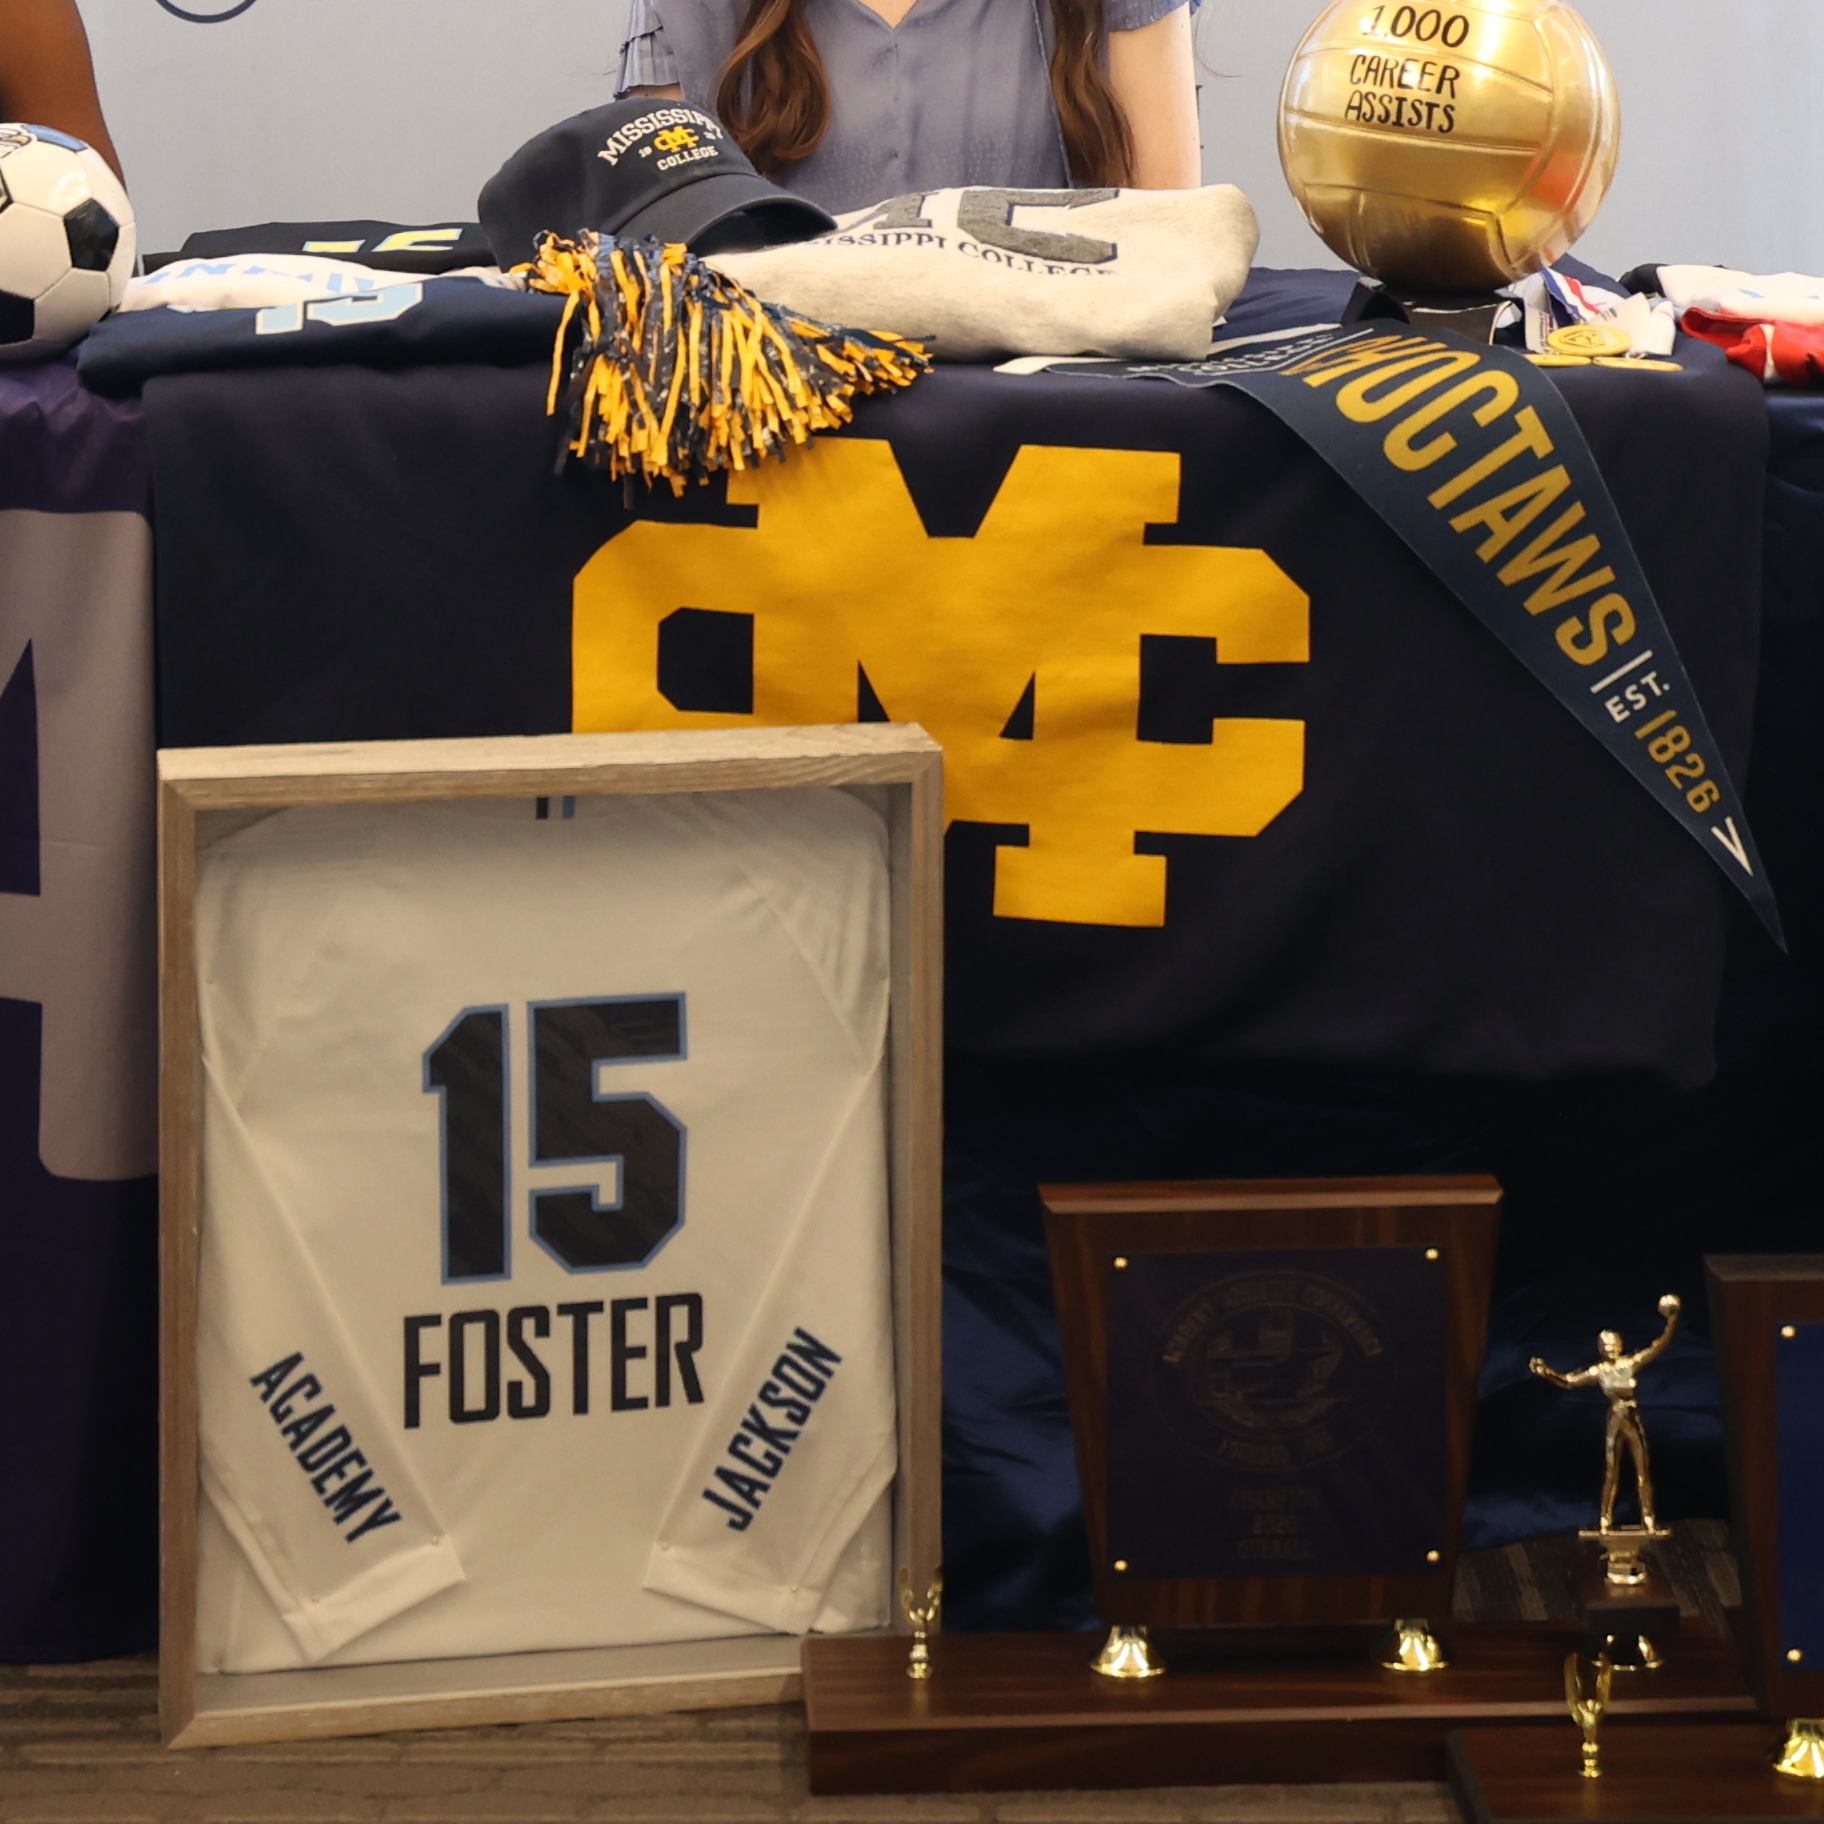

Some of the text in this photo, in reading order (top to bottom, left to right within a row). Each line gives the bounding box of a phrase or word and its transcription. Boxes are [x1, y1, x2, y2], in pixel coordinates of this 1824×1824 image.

[1344, 89, 1456, 135] ASSISTS
[1349, 53, 1461, 100] CAREER
[656, 145, 720, 172] COLLEGE
[1604, 670, 1722, 814] EST. 1826
[422, 991, 688, 1285] 15
[402, 1291, 705, 1430] FOSTER
[699, 1325, 844, 1535] JACKSON
[249, 1350, 401, 1546] ACADEMY
